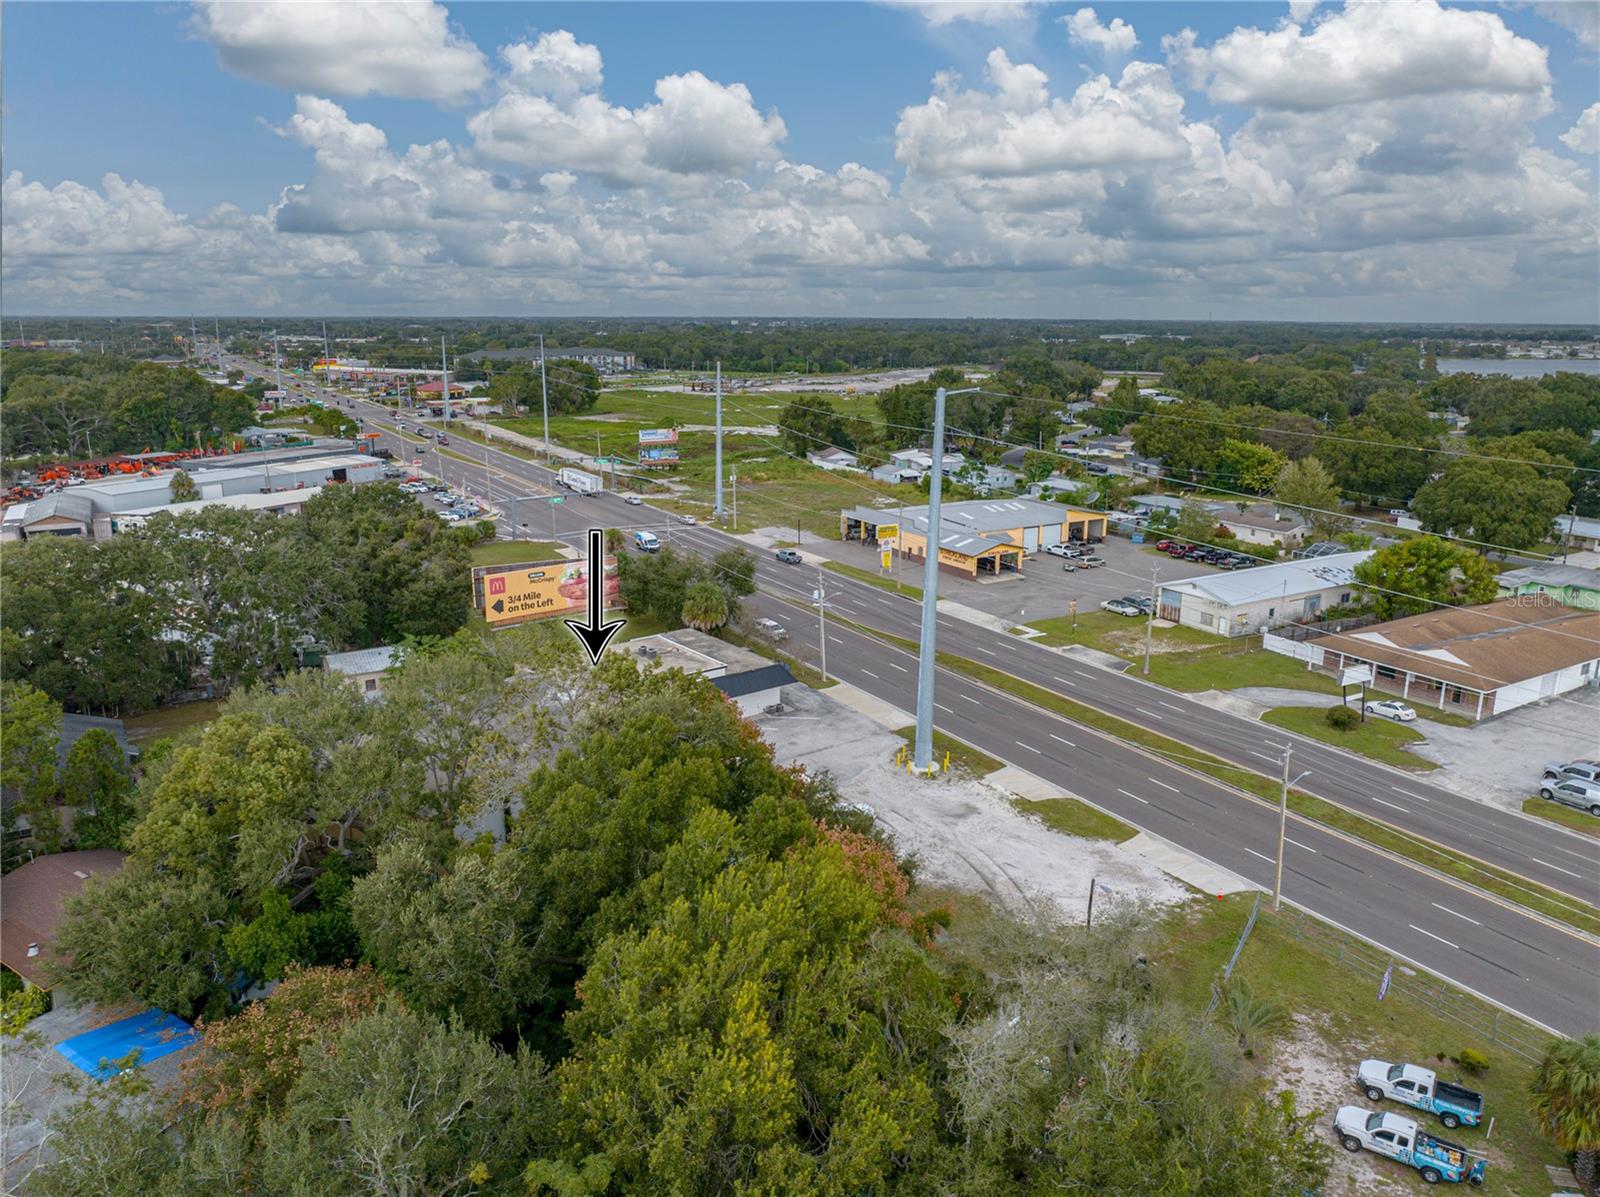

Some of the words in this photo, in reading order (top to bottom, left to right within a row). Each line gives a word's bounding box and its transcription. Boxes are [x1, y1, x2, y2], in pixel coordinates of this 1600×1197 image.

[508, 595, 522, 604] 3/4
[523, 592, 542, 601] Mile
[521, 602, 534, 610] the
[536, 598, 554, 608] Left
